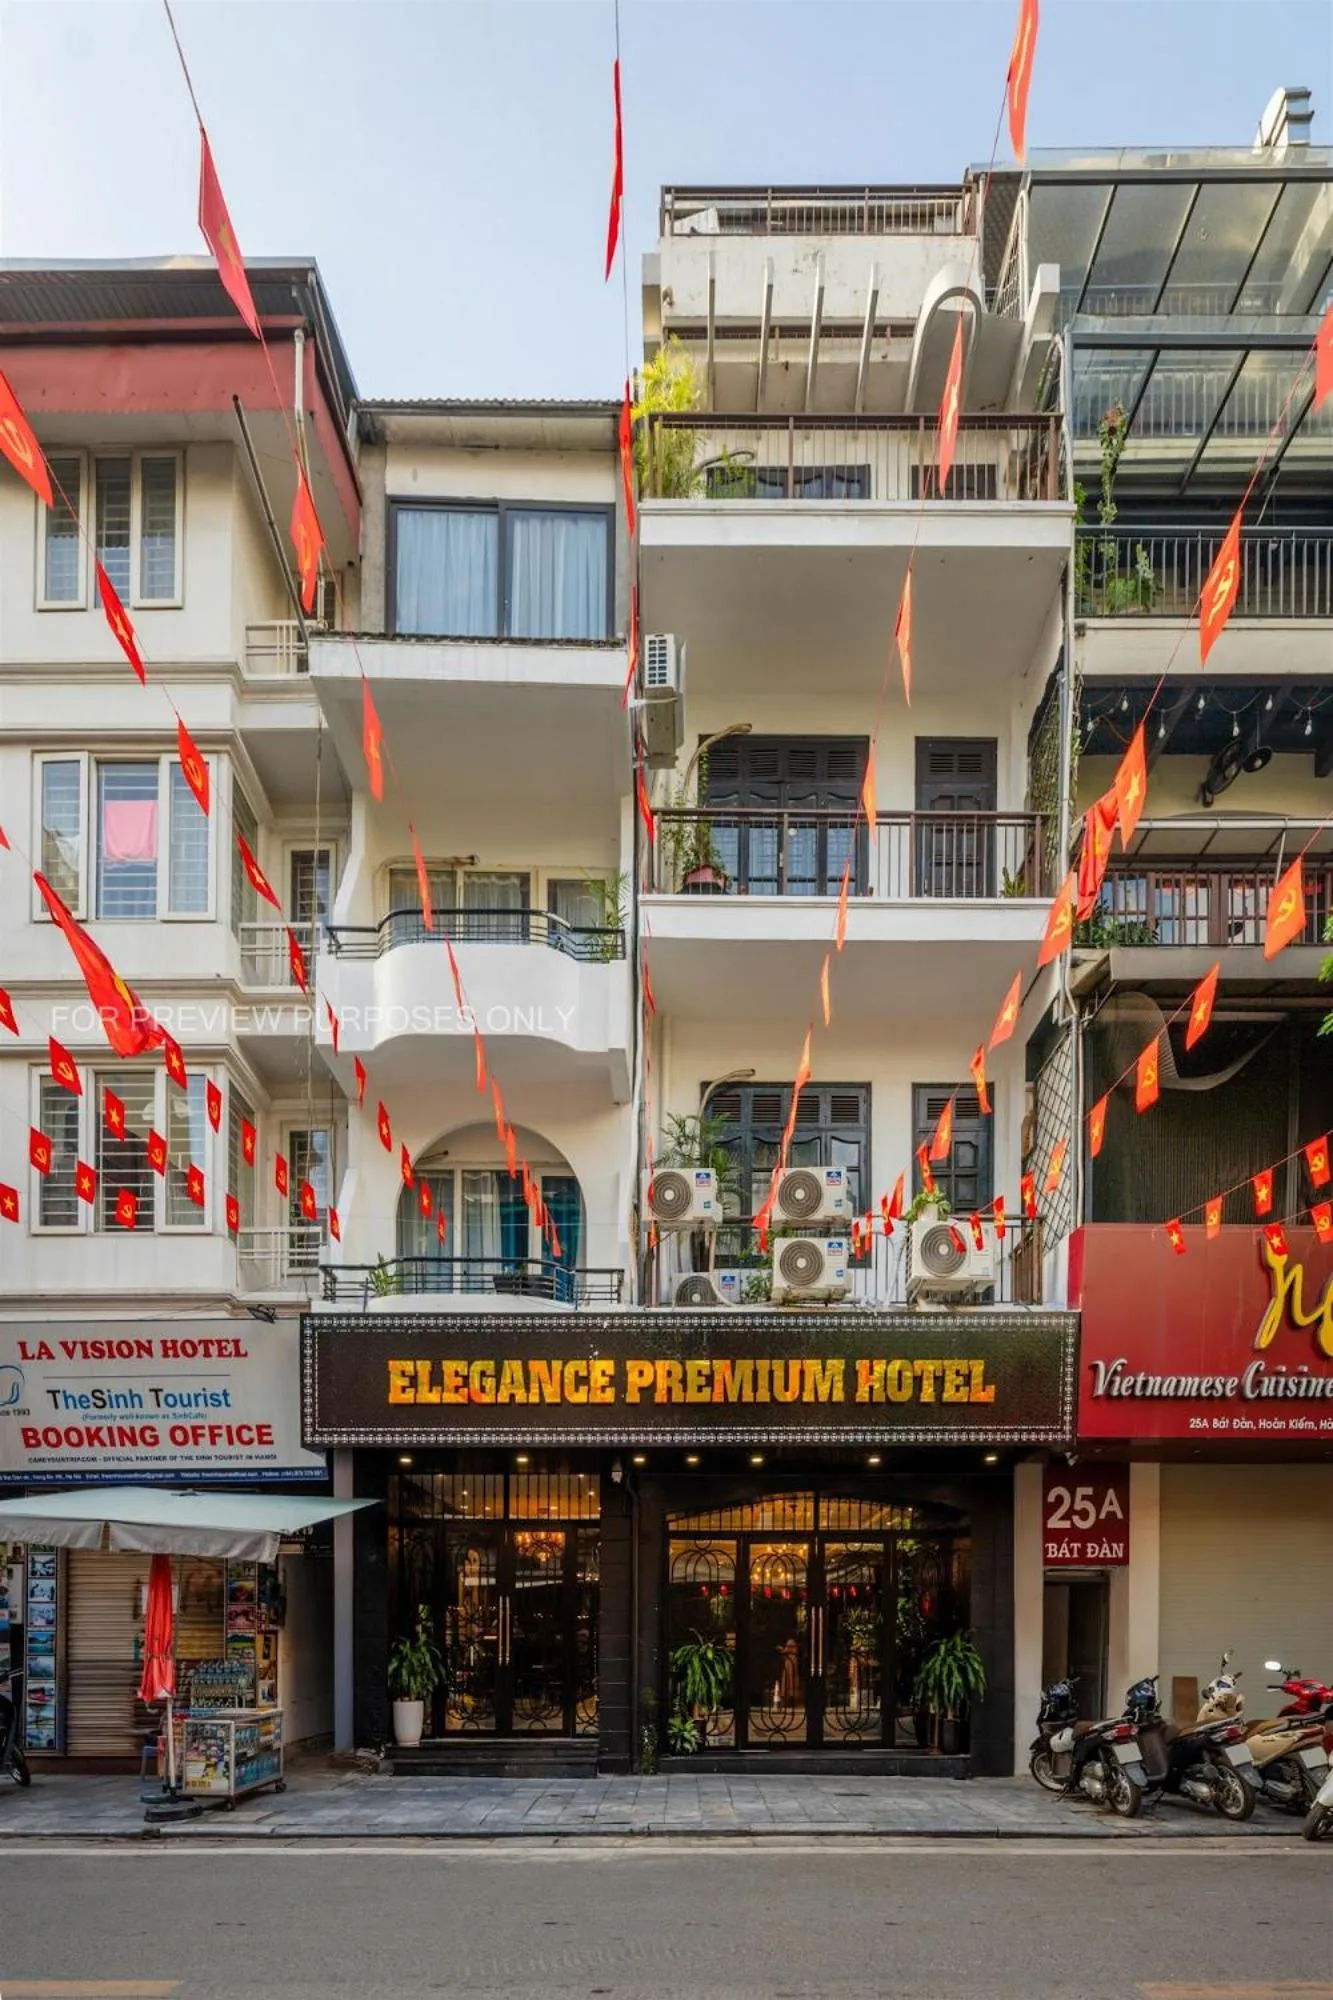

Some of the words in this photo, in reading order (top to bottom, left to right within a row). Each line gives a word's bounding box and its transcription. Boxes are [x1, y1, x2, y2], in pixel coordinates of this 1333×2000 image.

[17, 1341, 55, 1361] LA
[59, 1339, 154, 1360] VISION
[161, 1338, 248, 1358] HOTEL
[387, 1359, 616, 1404] ELEGANCE
[624, 1359, 846, 1404] PREMIUM
[854, 1359, 995, 1404] HOTEL
[1089, 1358, 1240, 1399] Vietnamese
[1242, 1359, 1333, 1399] Cuisine
[46, 1388, 144, 1410] TheSinh
[149, 1387, 231, 1408] Tourist
[1189, 1418, 1210, 1430] 25A
[1212, 1416, 1230, 1430] Bát
[1233, 1417, 1257, 1431] Đàn,
[21, 1425, 160, 1449] BOOKING
[169, 1424, 275, 1446] OFFICE
[1046, 1487, 1124, 1530] 25A
[1045, 1538, 1082, 1559] BÁT
[1086, 1536, 1124, 1559] ĐÀN
